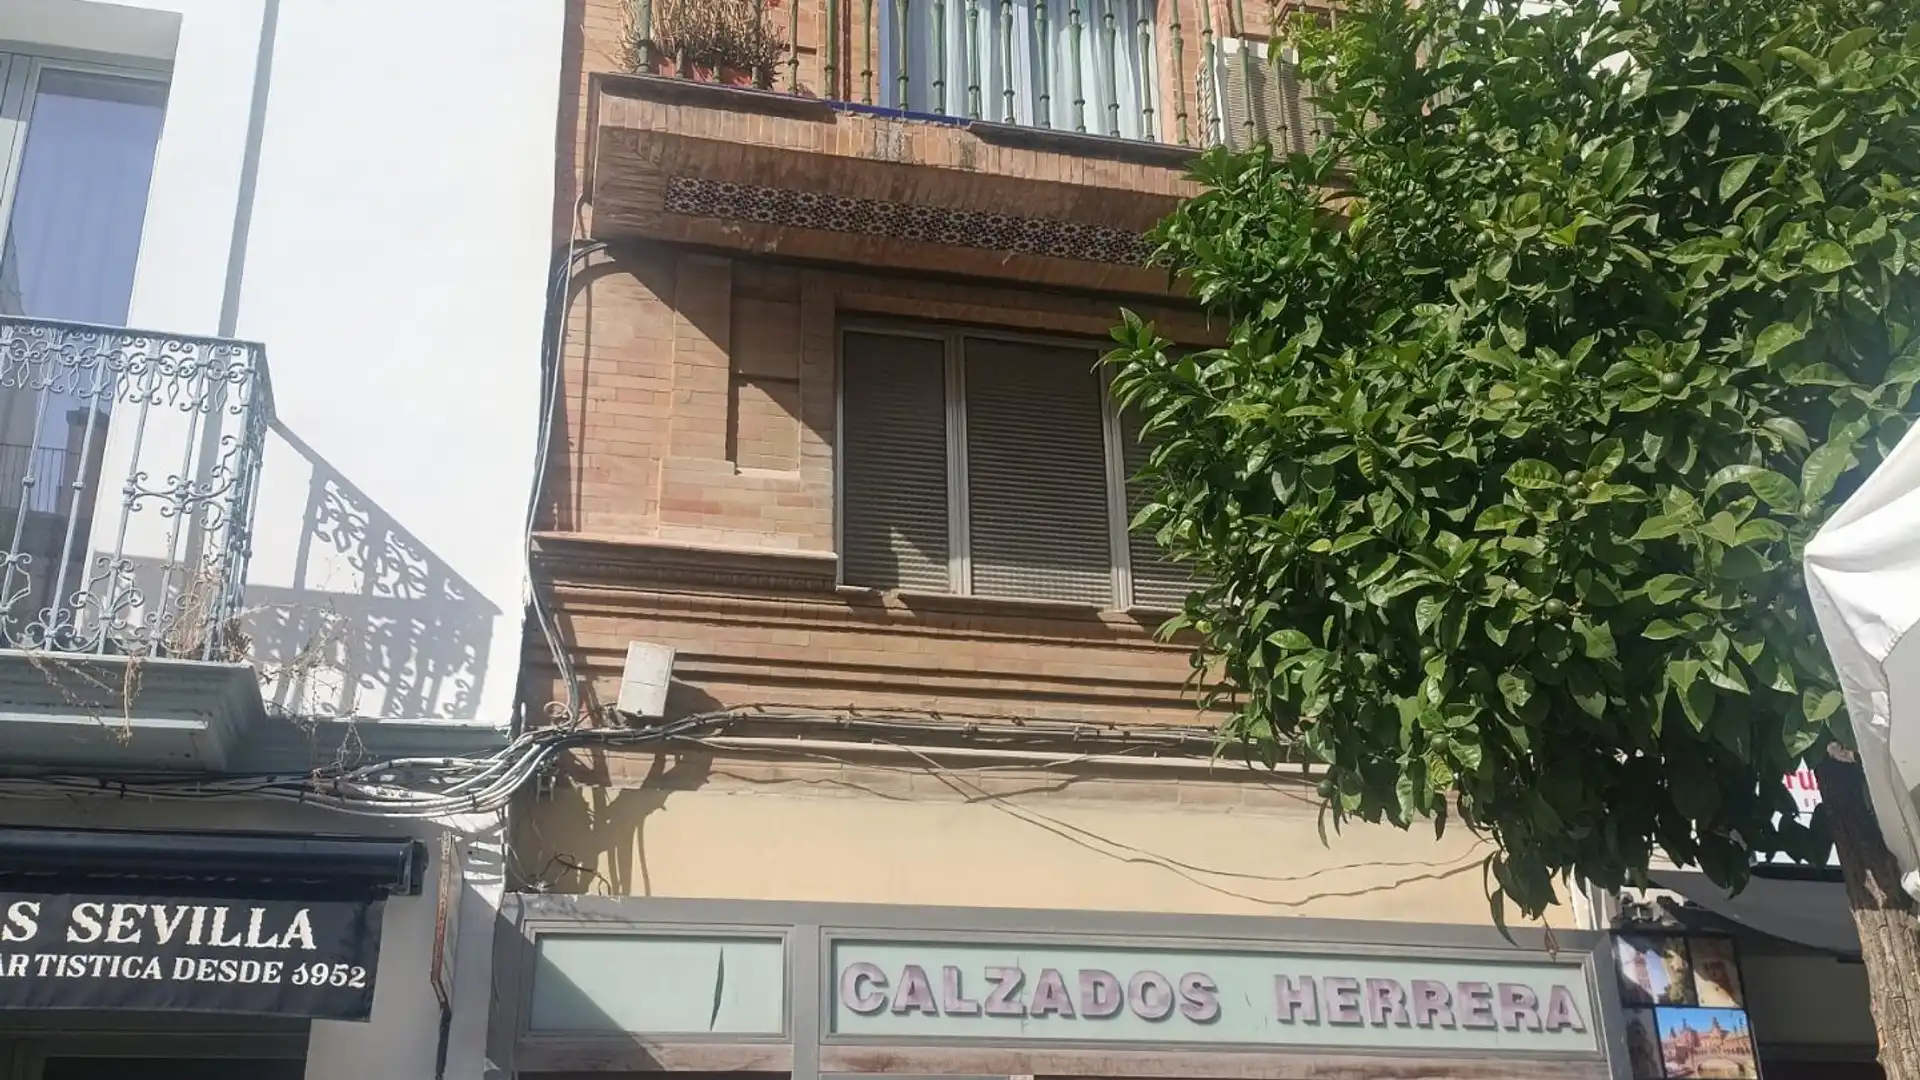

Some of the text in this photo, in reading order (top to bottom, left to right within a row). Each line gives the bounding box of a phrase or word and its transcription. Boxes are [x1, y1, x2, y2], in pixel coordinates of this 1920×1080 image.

[66, 902, 317, 950] SEVILLA
[0, 953, 367, 988] RTISTICA DESDE 1952
[840, 961, 1587, 1033] CALZADOS HERRERA
